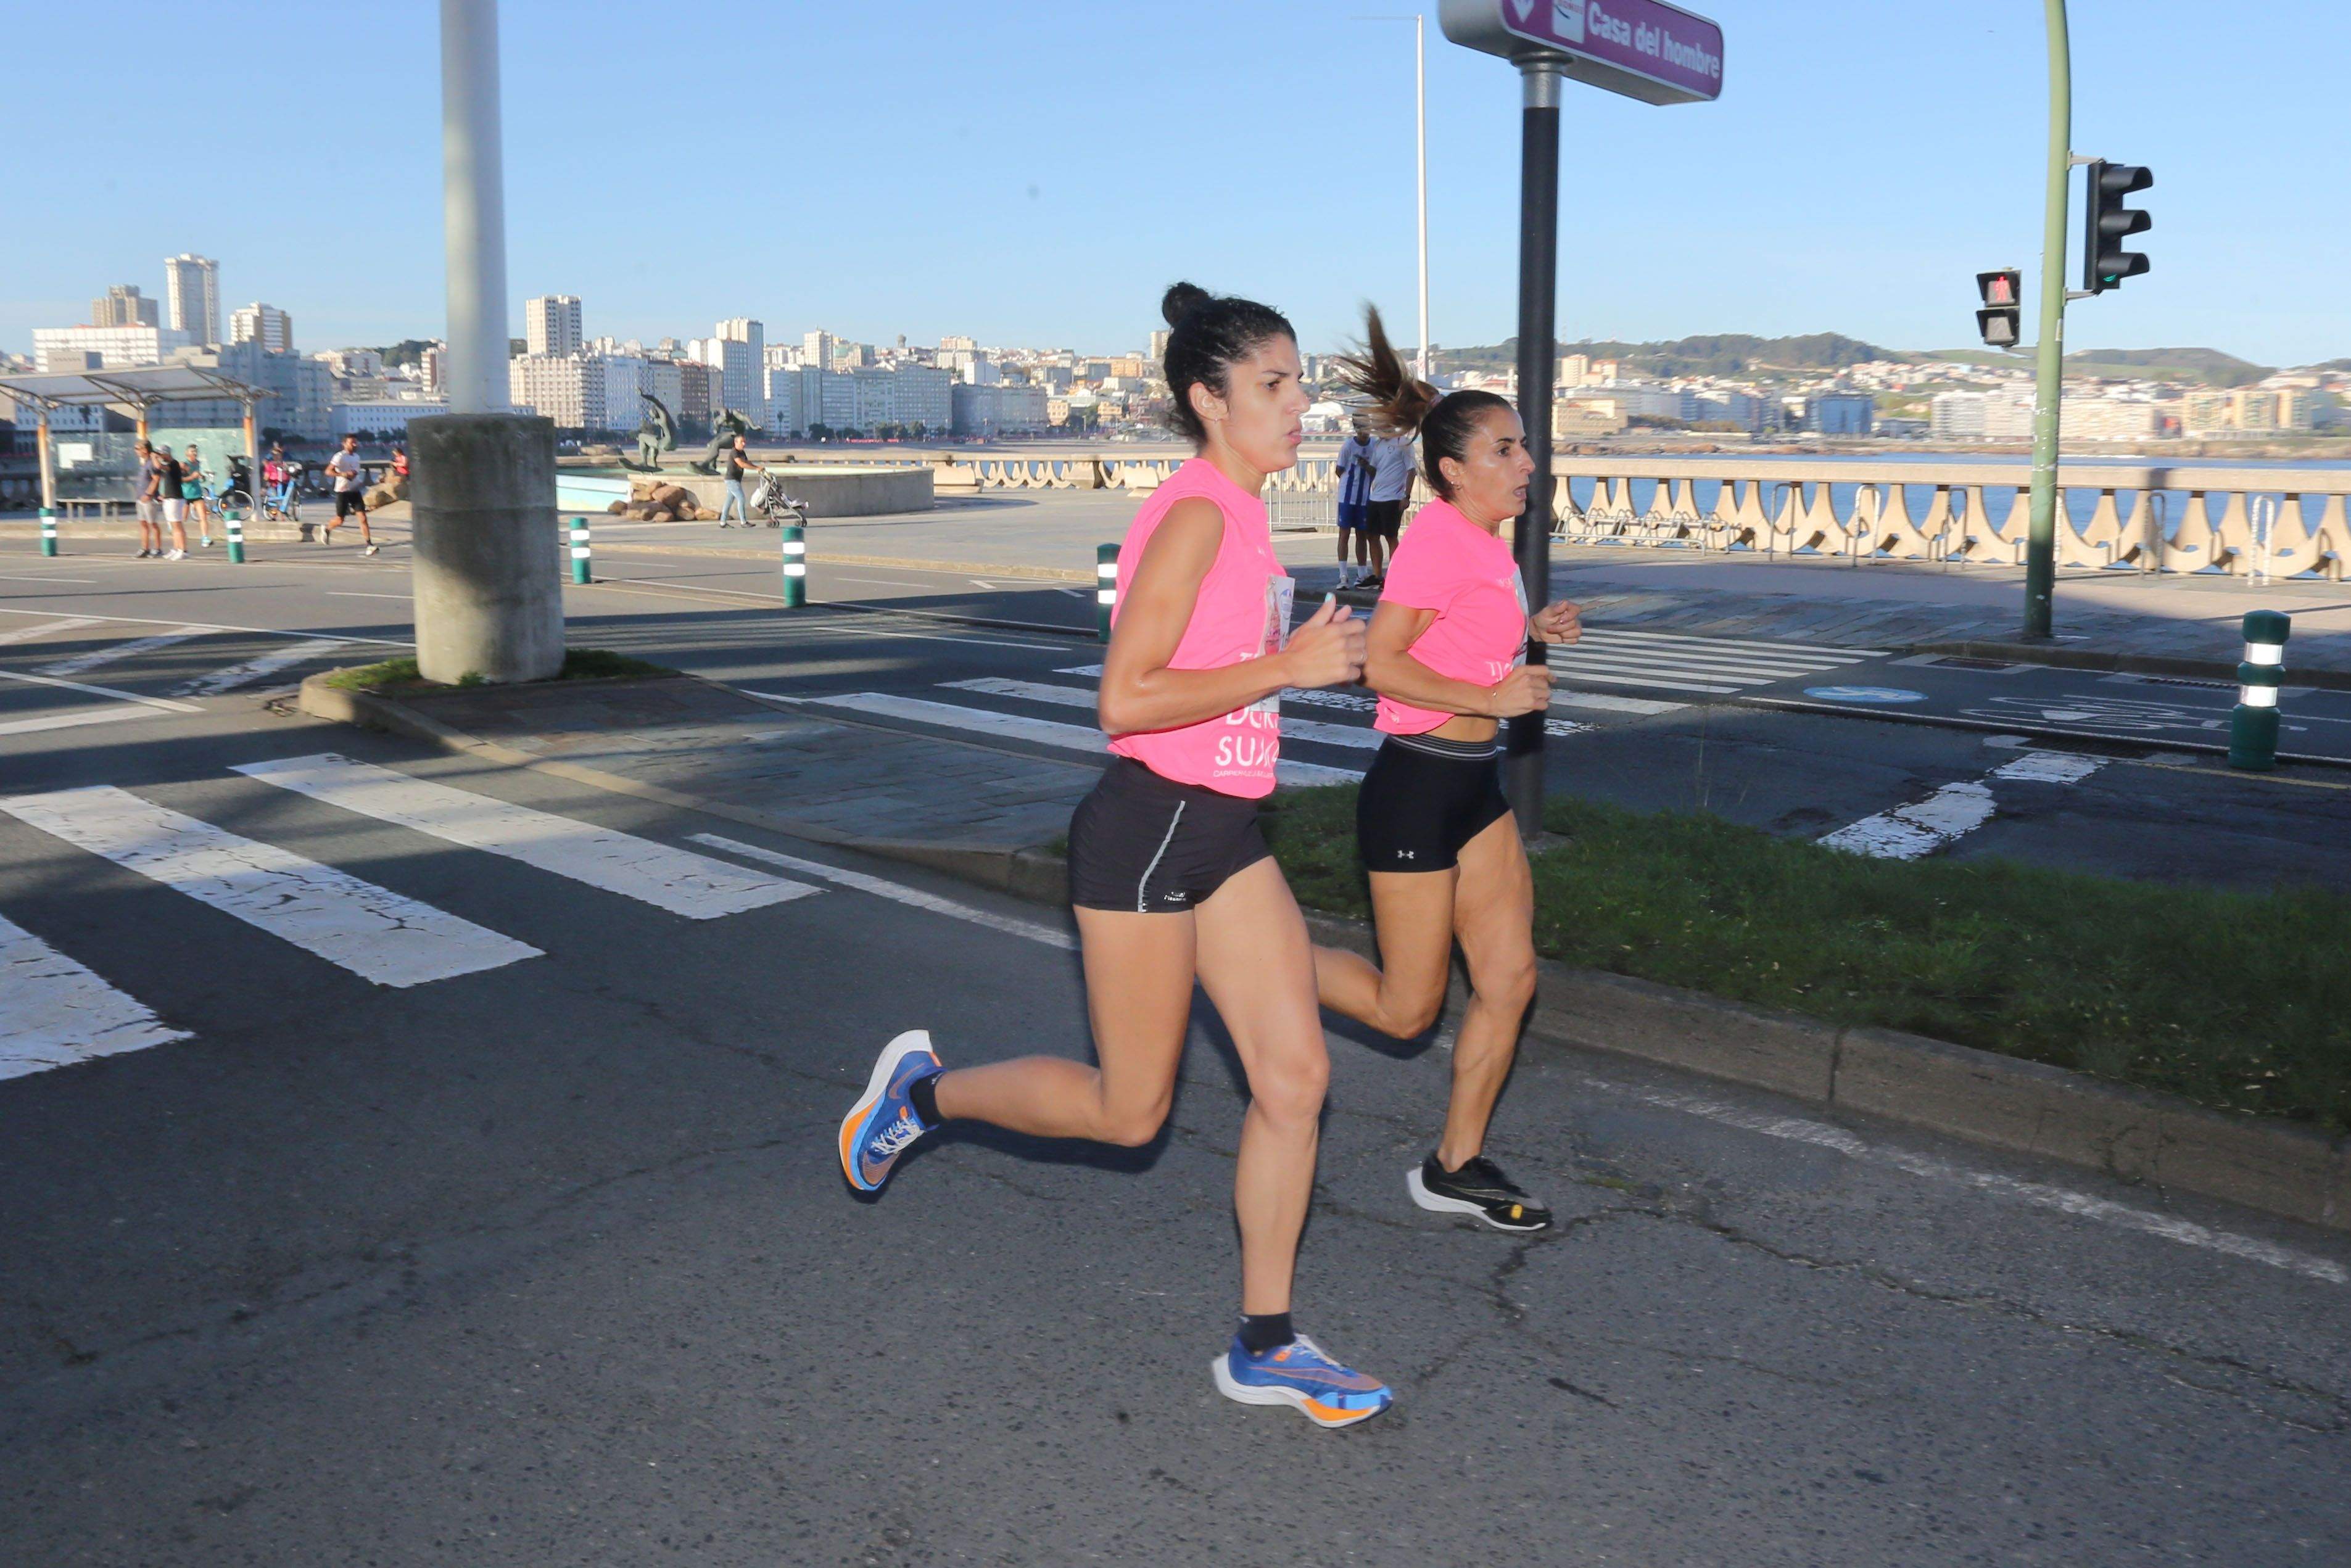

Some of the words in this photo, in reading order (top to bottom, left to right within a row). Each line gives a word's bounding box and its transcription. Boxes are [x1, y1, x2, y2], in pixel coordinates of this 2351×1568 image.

[1589, 1, 1631, 47] Casa
[1635, 21, 1659, 57] del
[1663, 30, 1720, 80] hombre
